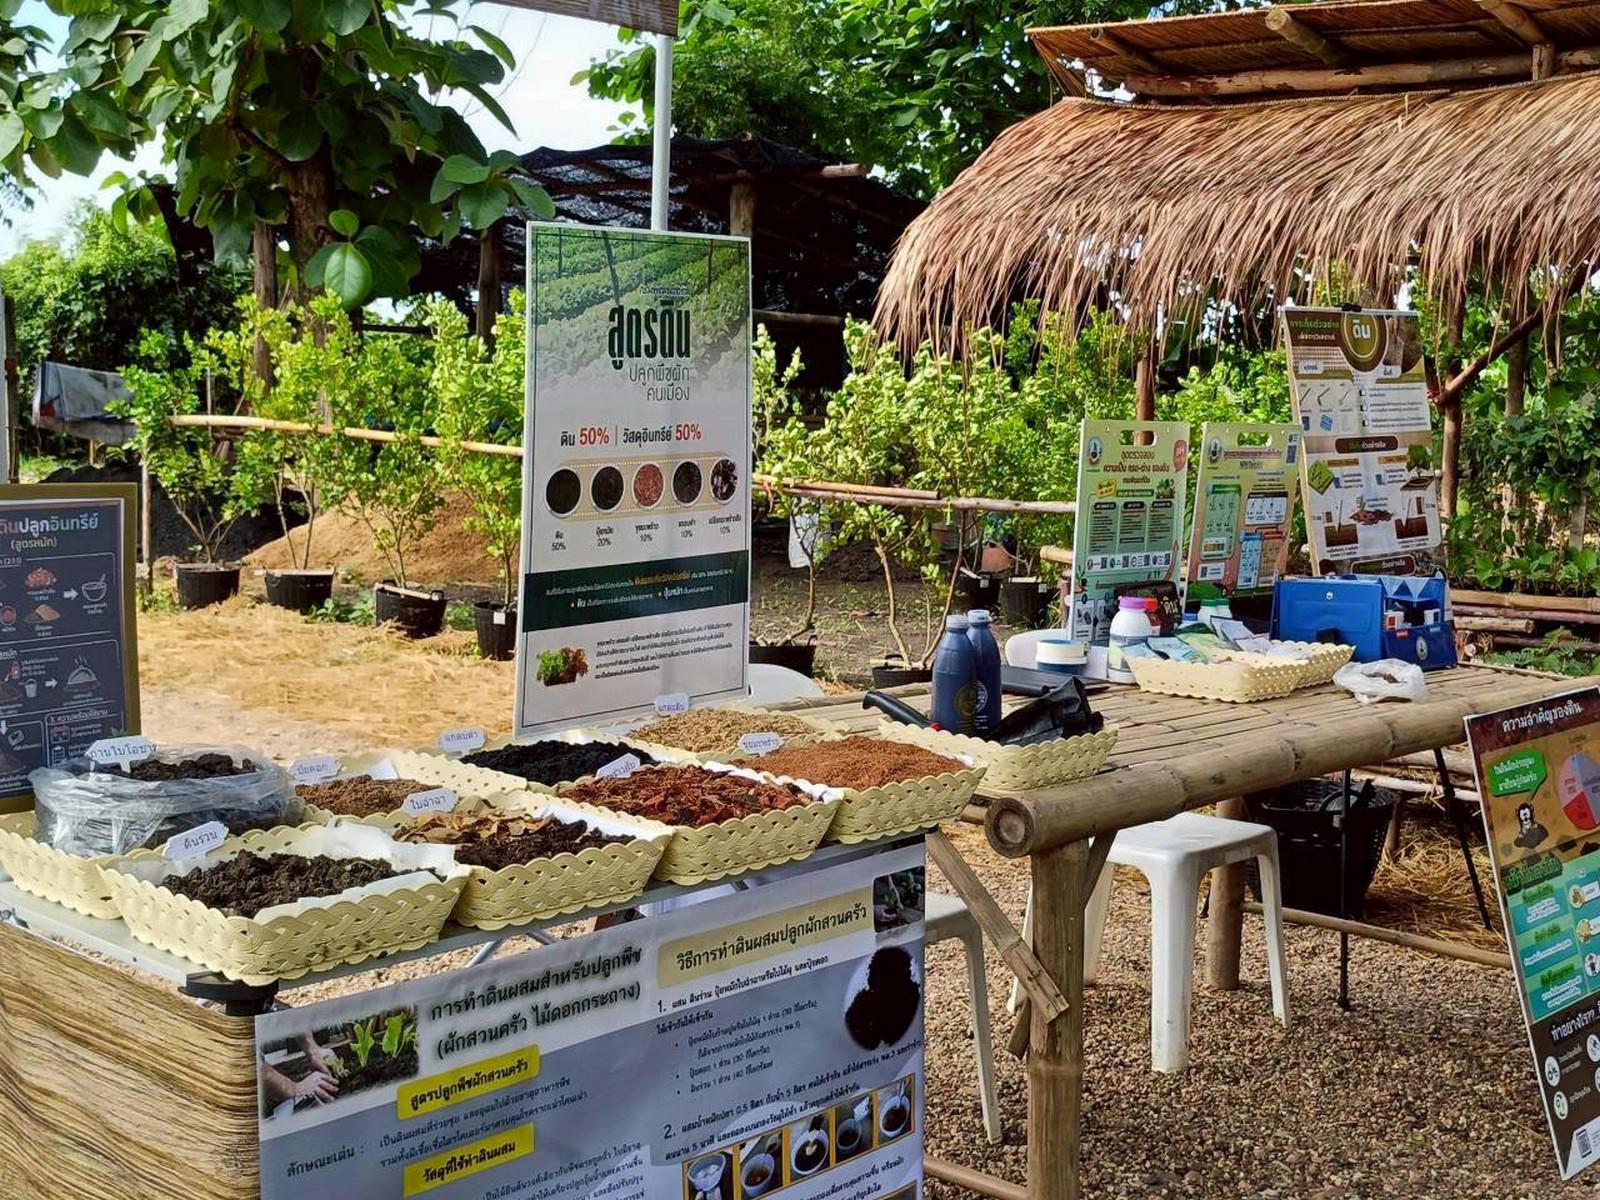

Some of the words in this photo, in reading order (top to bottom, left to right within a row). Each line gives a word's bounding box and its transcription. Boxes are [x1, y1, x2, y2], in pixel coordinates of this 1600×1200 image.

[608, 299, 691, 371] สูตรดิน
[1352, 319, 1371, 339] ดิน
[629, 362, 690, 387] ปลูกพืชผัก
[646, 382, 690, 402] คนเมือง
[560, 431, 576, 447] ดิน
[579, 427, 610, 446] 50%
[622, 425, 673, 449] วัสดุอินทรีย์
[675, 423, 702, 442] 50%
[677, 903, 867, 971] วิธีการทำดินผสมปลูกผักสวนครัว
[430, 945, 641, 1021] การทำดินผสมสำหรับปลูกพืช
[436, 1017, 528, 1060] (ผักสวนครัว
[532, 981, 640, 1029] ไม้ดอกกระถาง)
[411, 1060, 529, 1111] สูตรปลูกพืชผักสวนครัว
[664, 1124, 676, 1139] 2.
[423, 1141, 516, 1184] วัสดุที่ใช้ทำดินผสม
